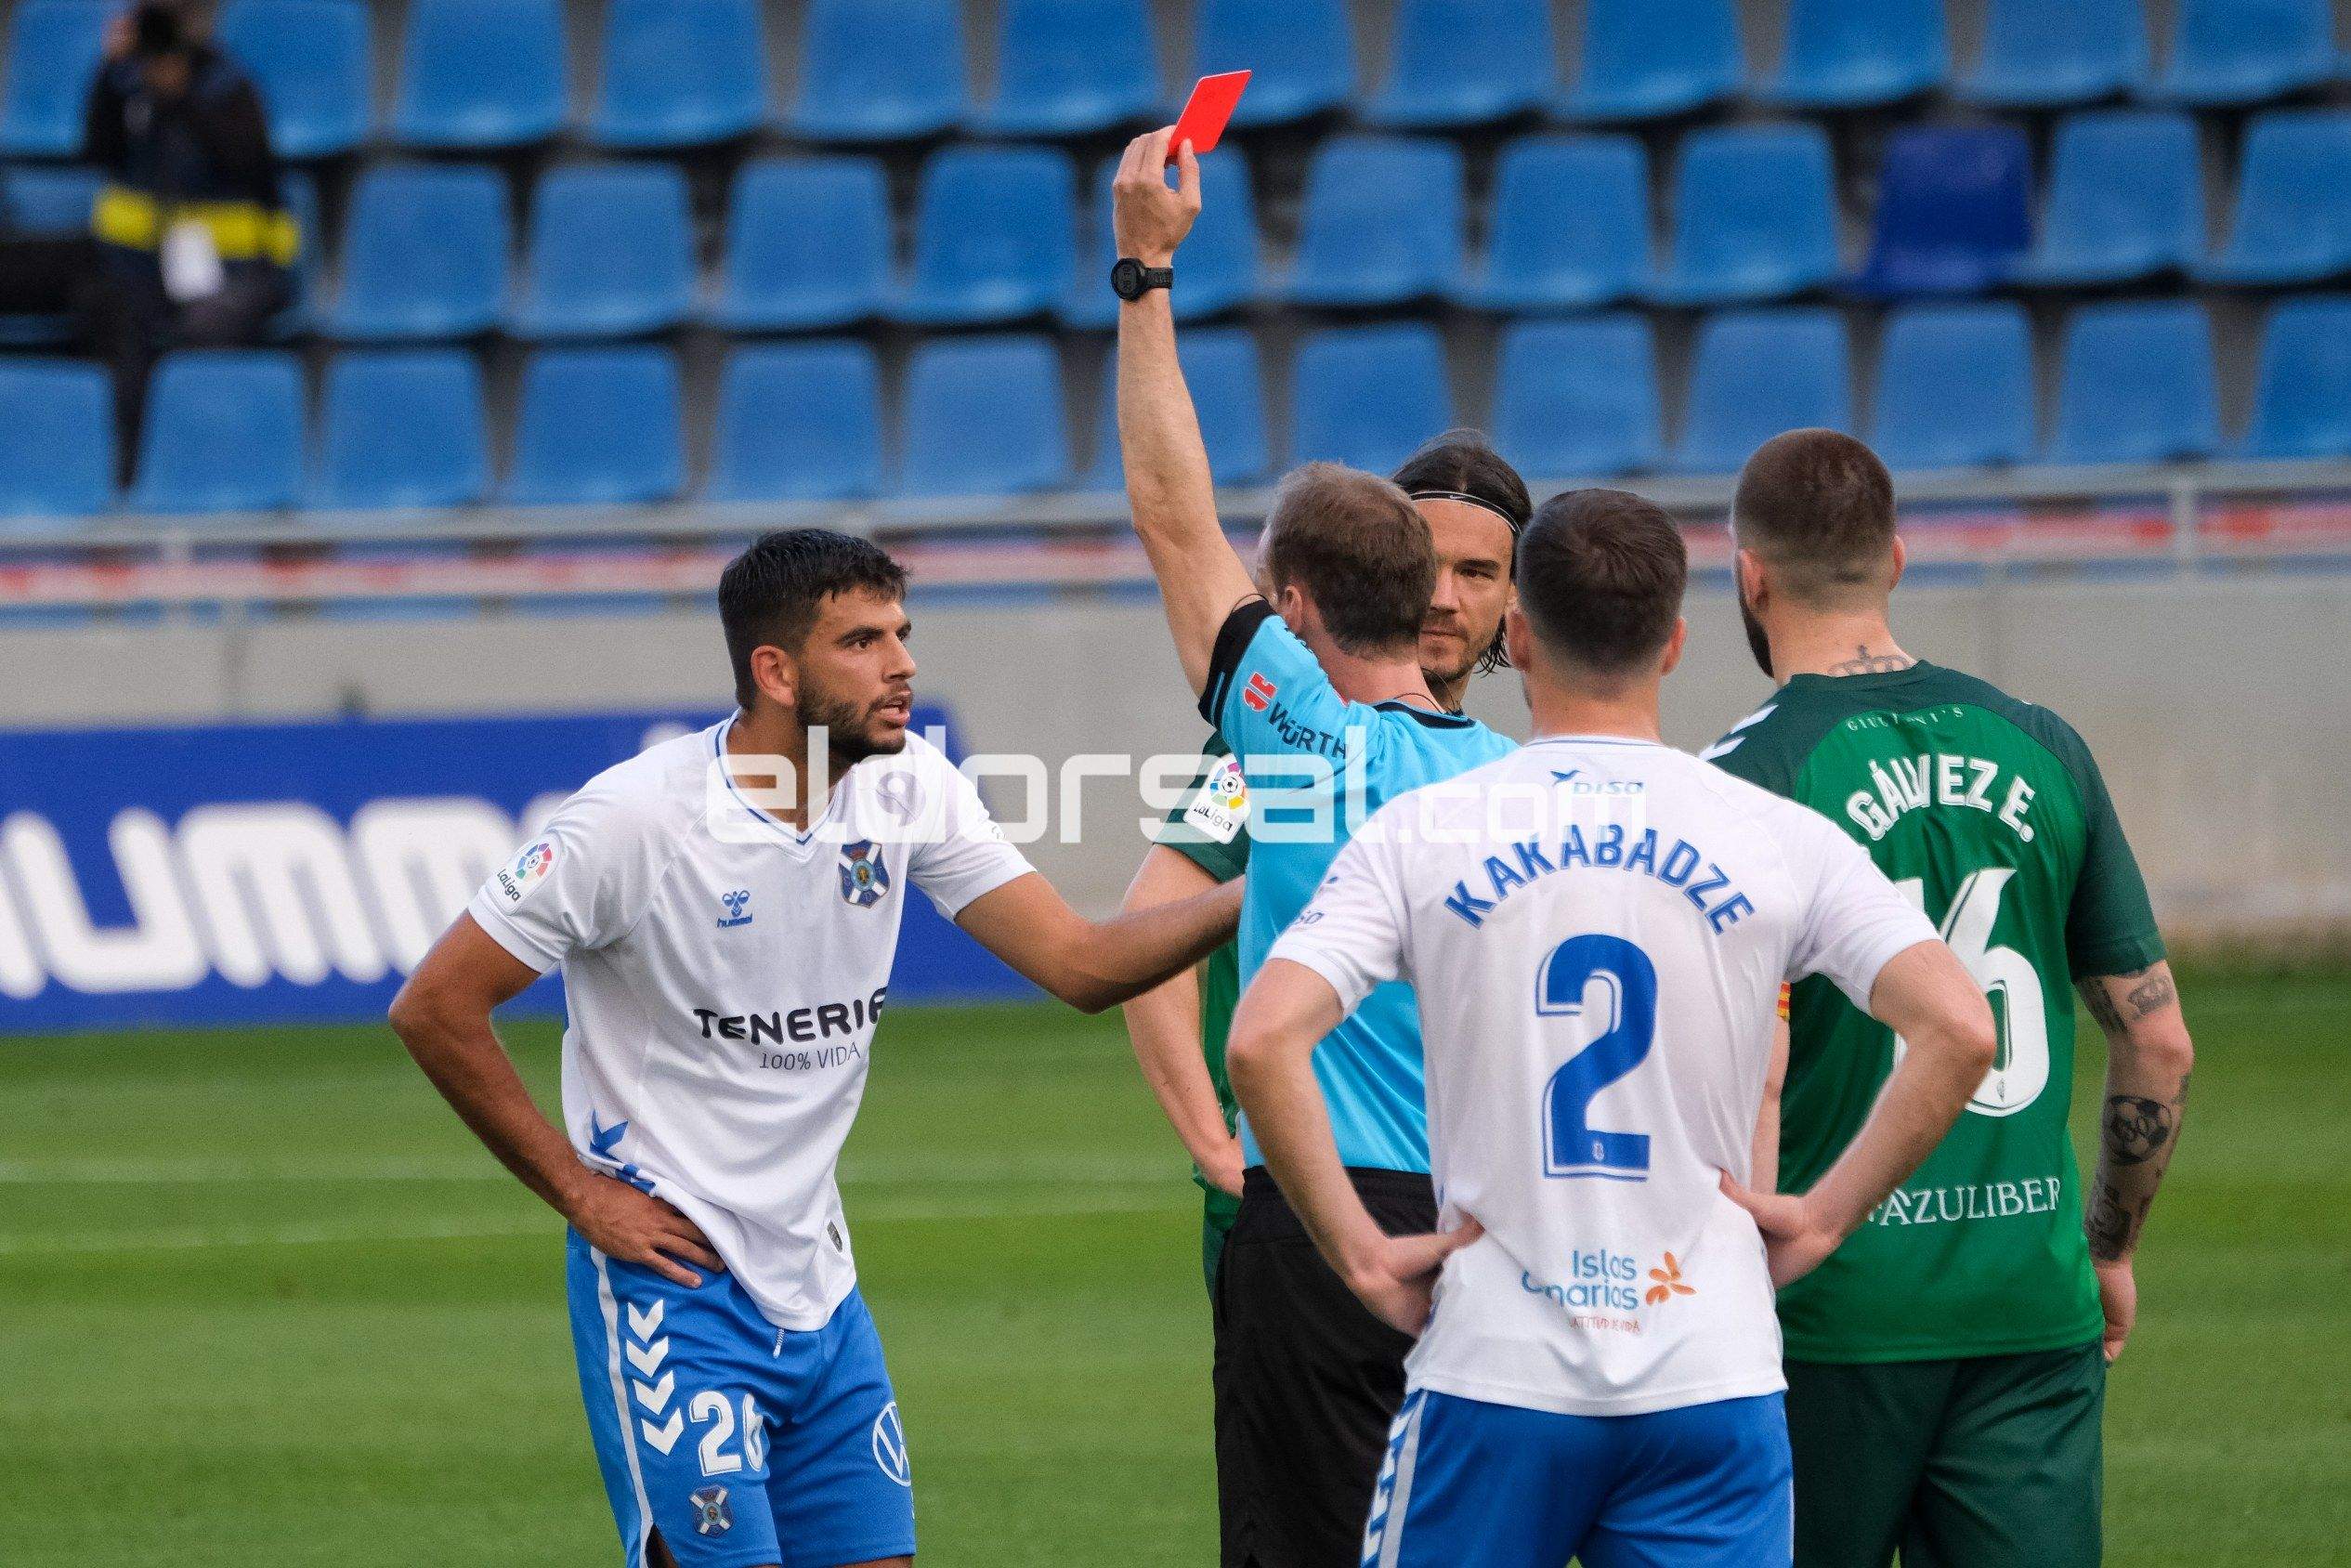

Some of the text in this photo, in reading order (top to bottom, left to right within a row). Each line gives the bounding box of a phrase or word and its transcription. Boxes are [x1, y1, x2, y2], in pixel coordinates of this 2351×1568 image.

[1999, 776, 2035, 843] E.
[0, 790, 581, 999] umm
[1443, 824, 1756, 934] KAKABADZE
[692, 986, 888, 1047] TENERIF
[1893, 868, 2050, 1117] 6
[759, 1041, 861, 1071] 100% VIDA
[1535, 933, 1659, 1182] 2
